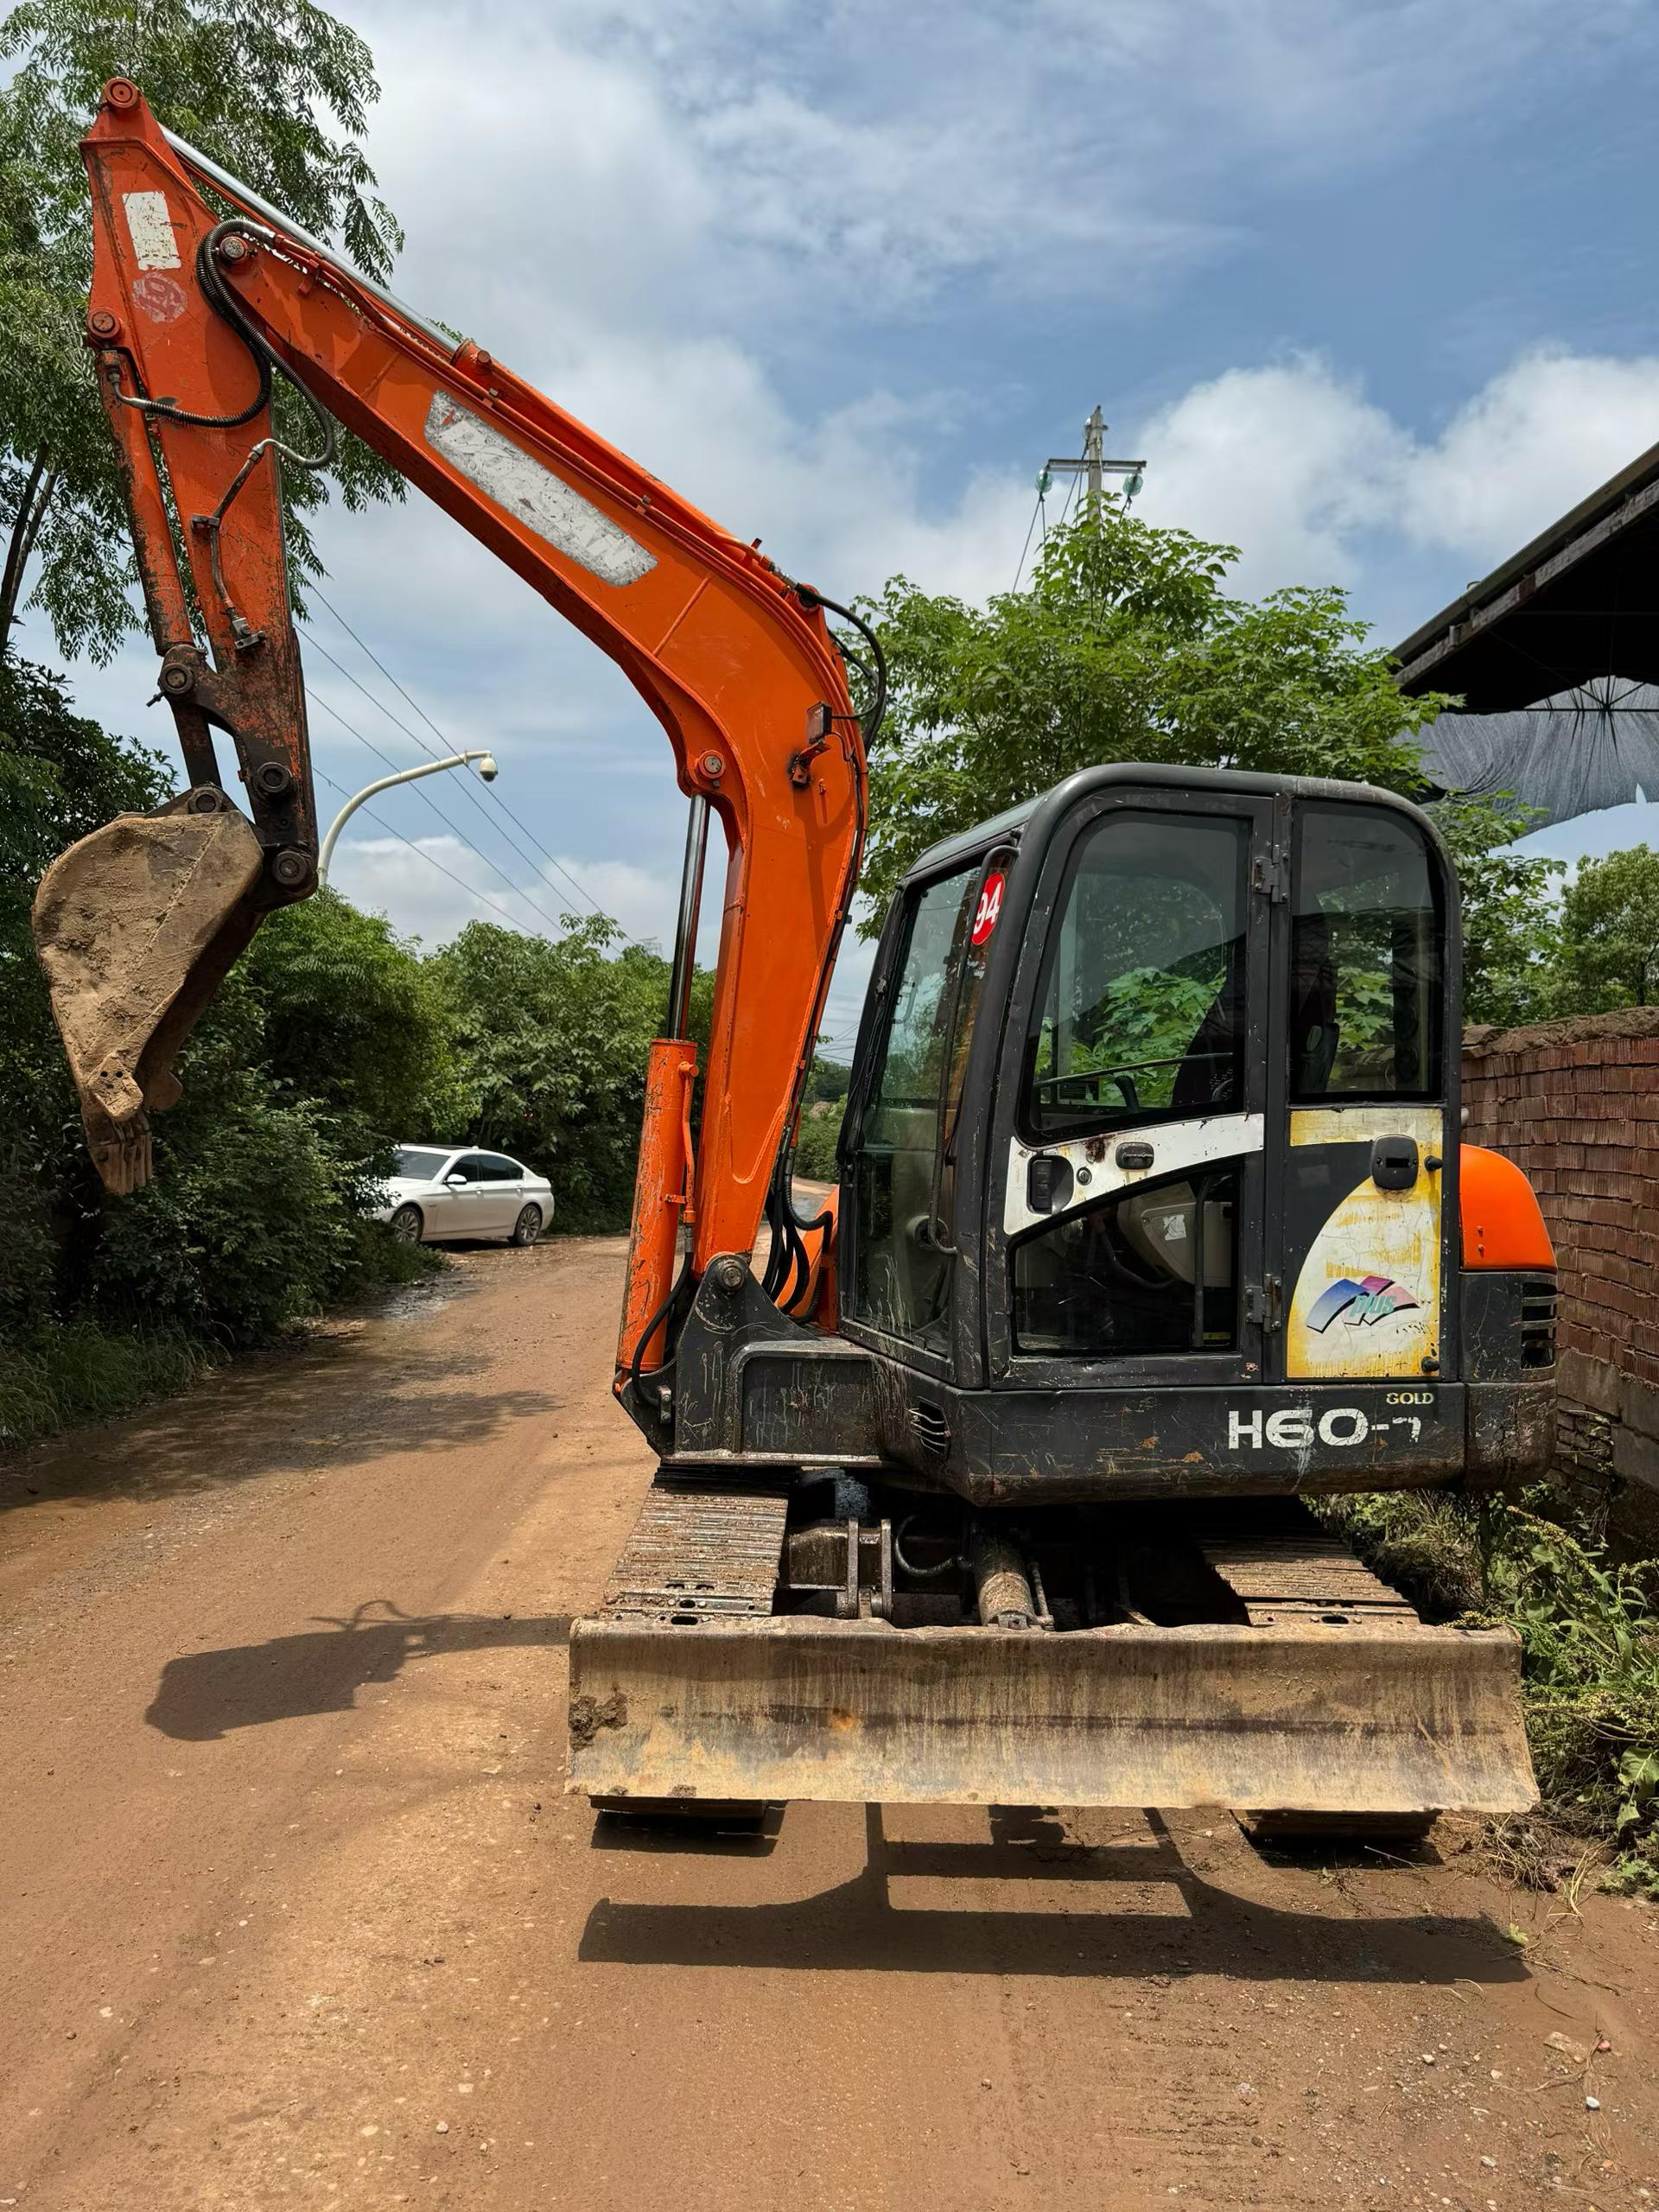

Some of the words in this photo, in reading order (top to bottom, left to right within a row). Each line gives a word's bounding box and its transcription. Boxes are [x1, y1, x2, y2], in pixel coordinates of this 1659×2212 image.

[973, 880, 1002, 935] 94
[1349, 1292, 1397, 1318] plus
[1386, 1392, 1434, 1405] GOLD
